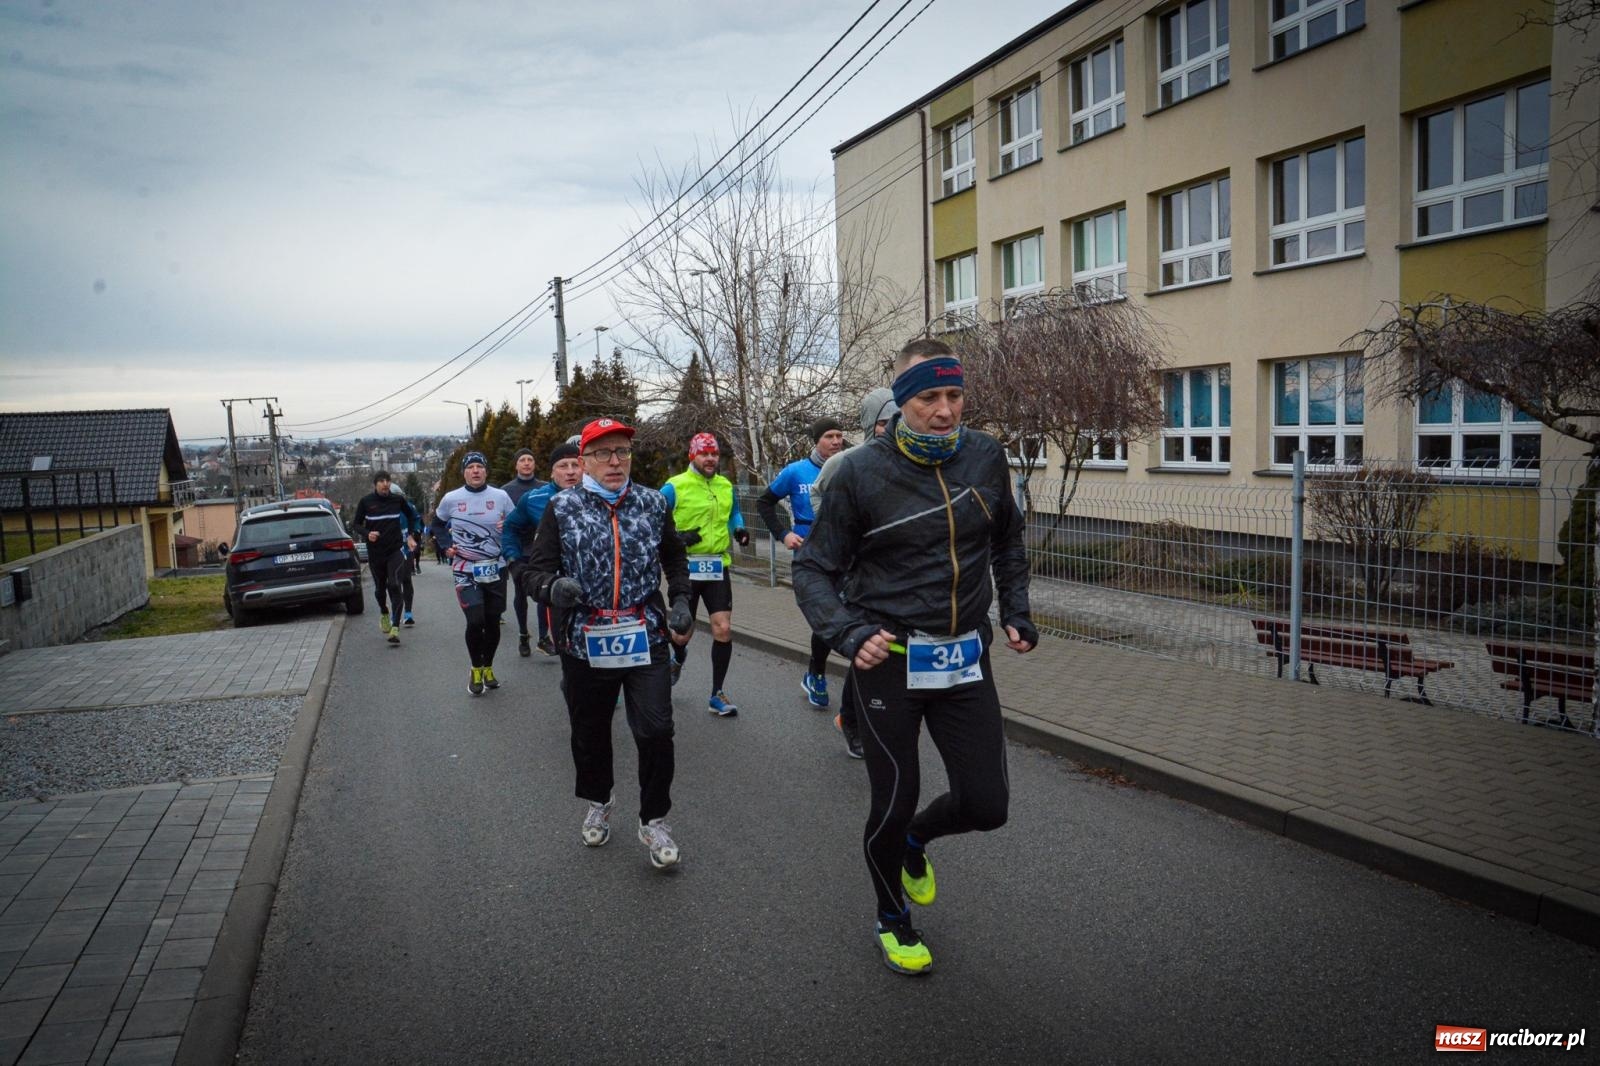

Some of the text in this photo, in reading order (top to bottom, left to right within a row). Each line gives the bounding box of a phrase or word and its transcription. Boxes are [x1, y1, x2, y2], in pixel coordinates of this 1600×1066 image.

[478, 565, 497, 577] 168
[698, 561, 714, 573] 85
[597, 633, 637, 655] 167
[931, 643, 965, 670] 34
